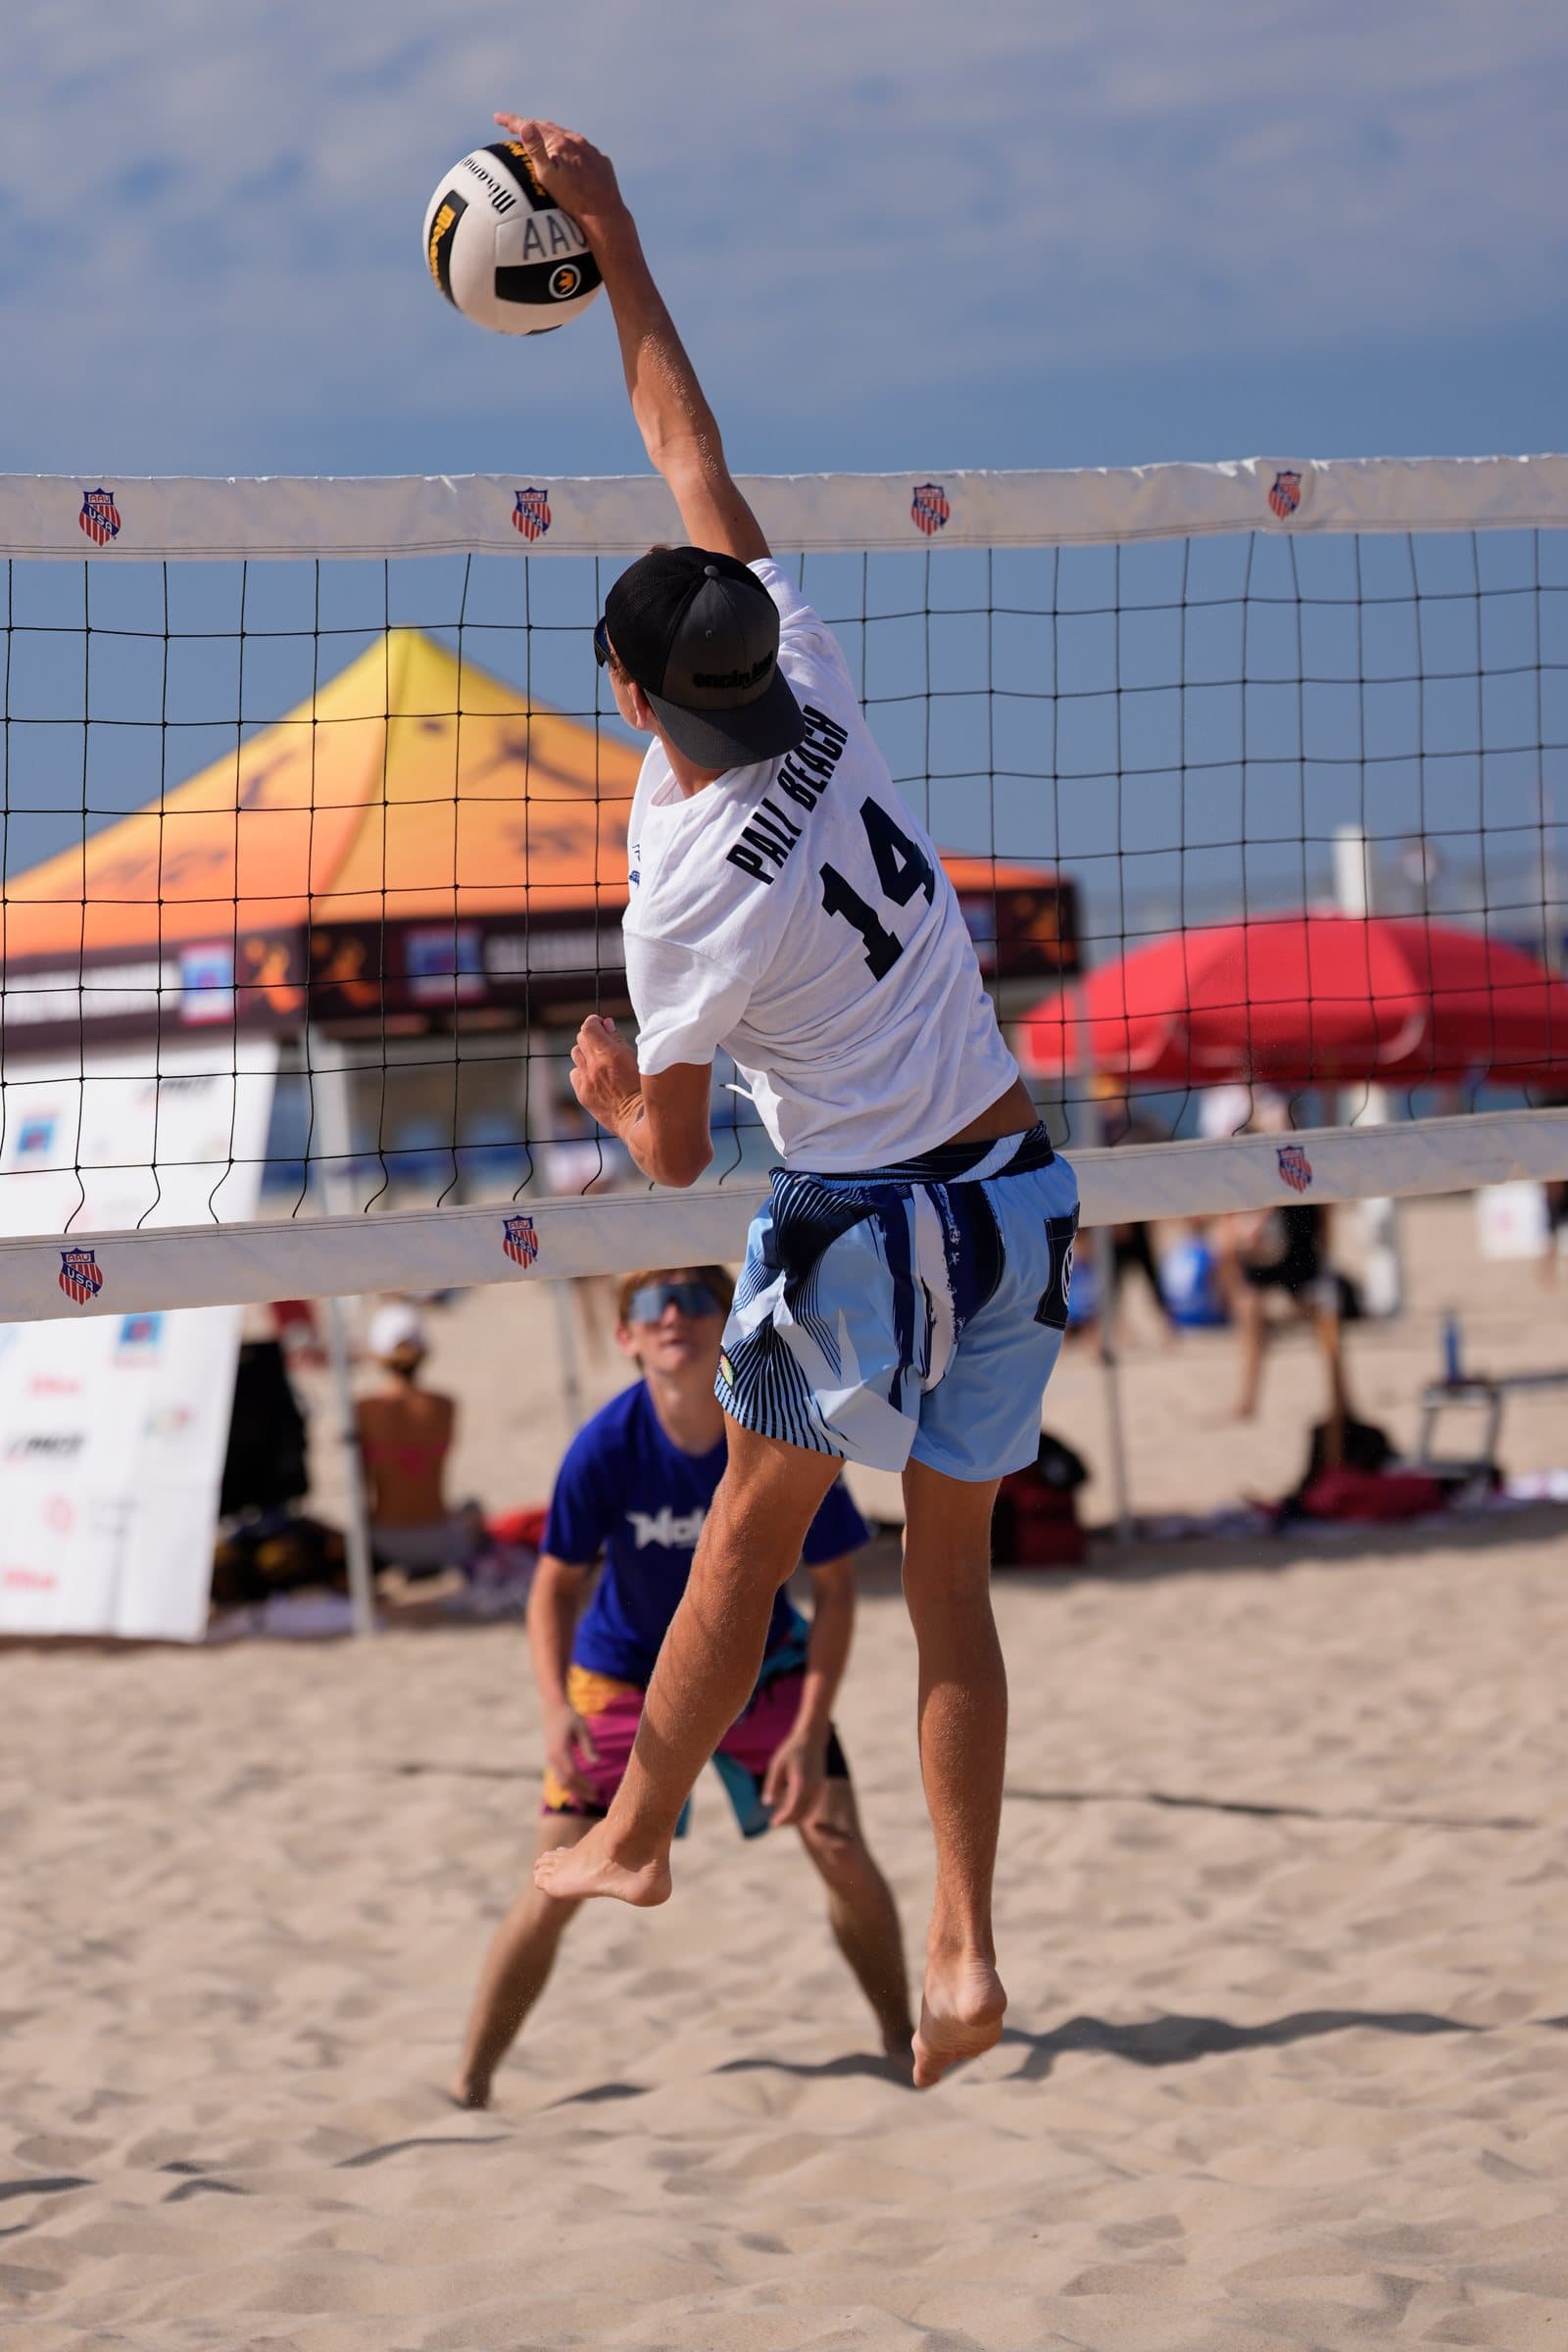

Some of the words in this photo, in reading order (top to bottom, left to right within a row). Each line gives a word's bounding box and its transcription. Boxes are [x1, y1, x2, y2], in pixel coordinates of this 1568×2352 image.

[89, 494, 110, 503] AAU
[88, 507, 114, 534] USA
[776, 704, 849, 813] BEACH
[818, 796, 935, 982] 14
[511, 1234, 533, 1255] USA
[67, 1253, 90, 1262] AAU
[67, 1267, 94, 1292] USA
